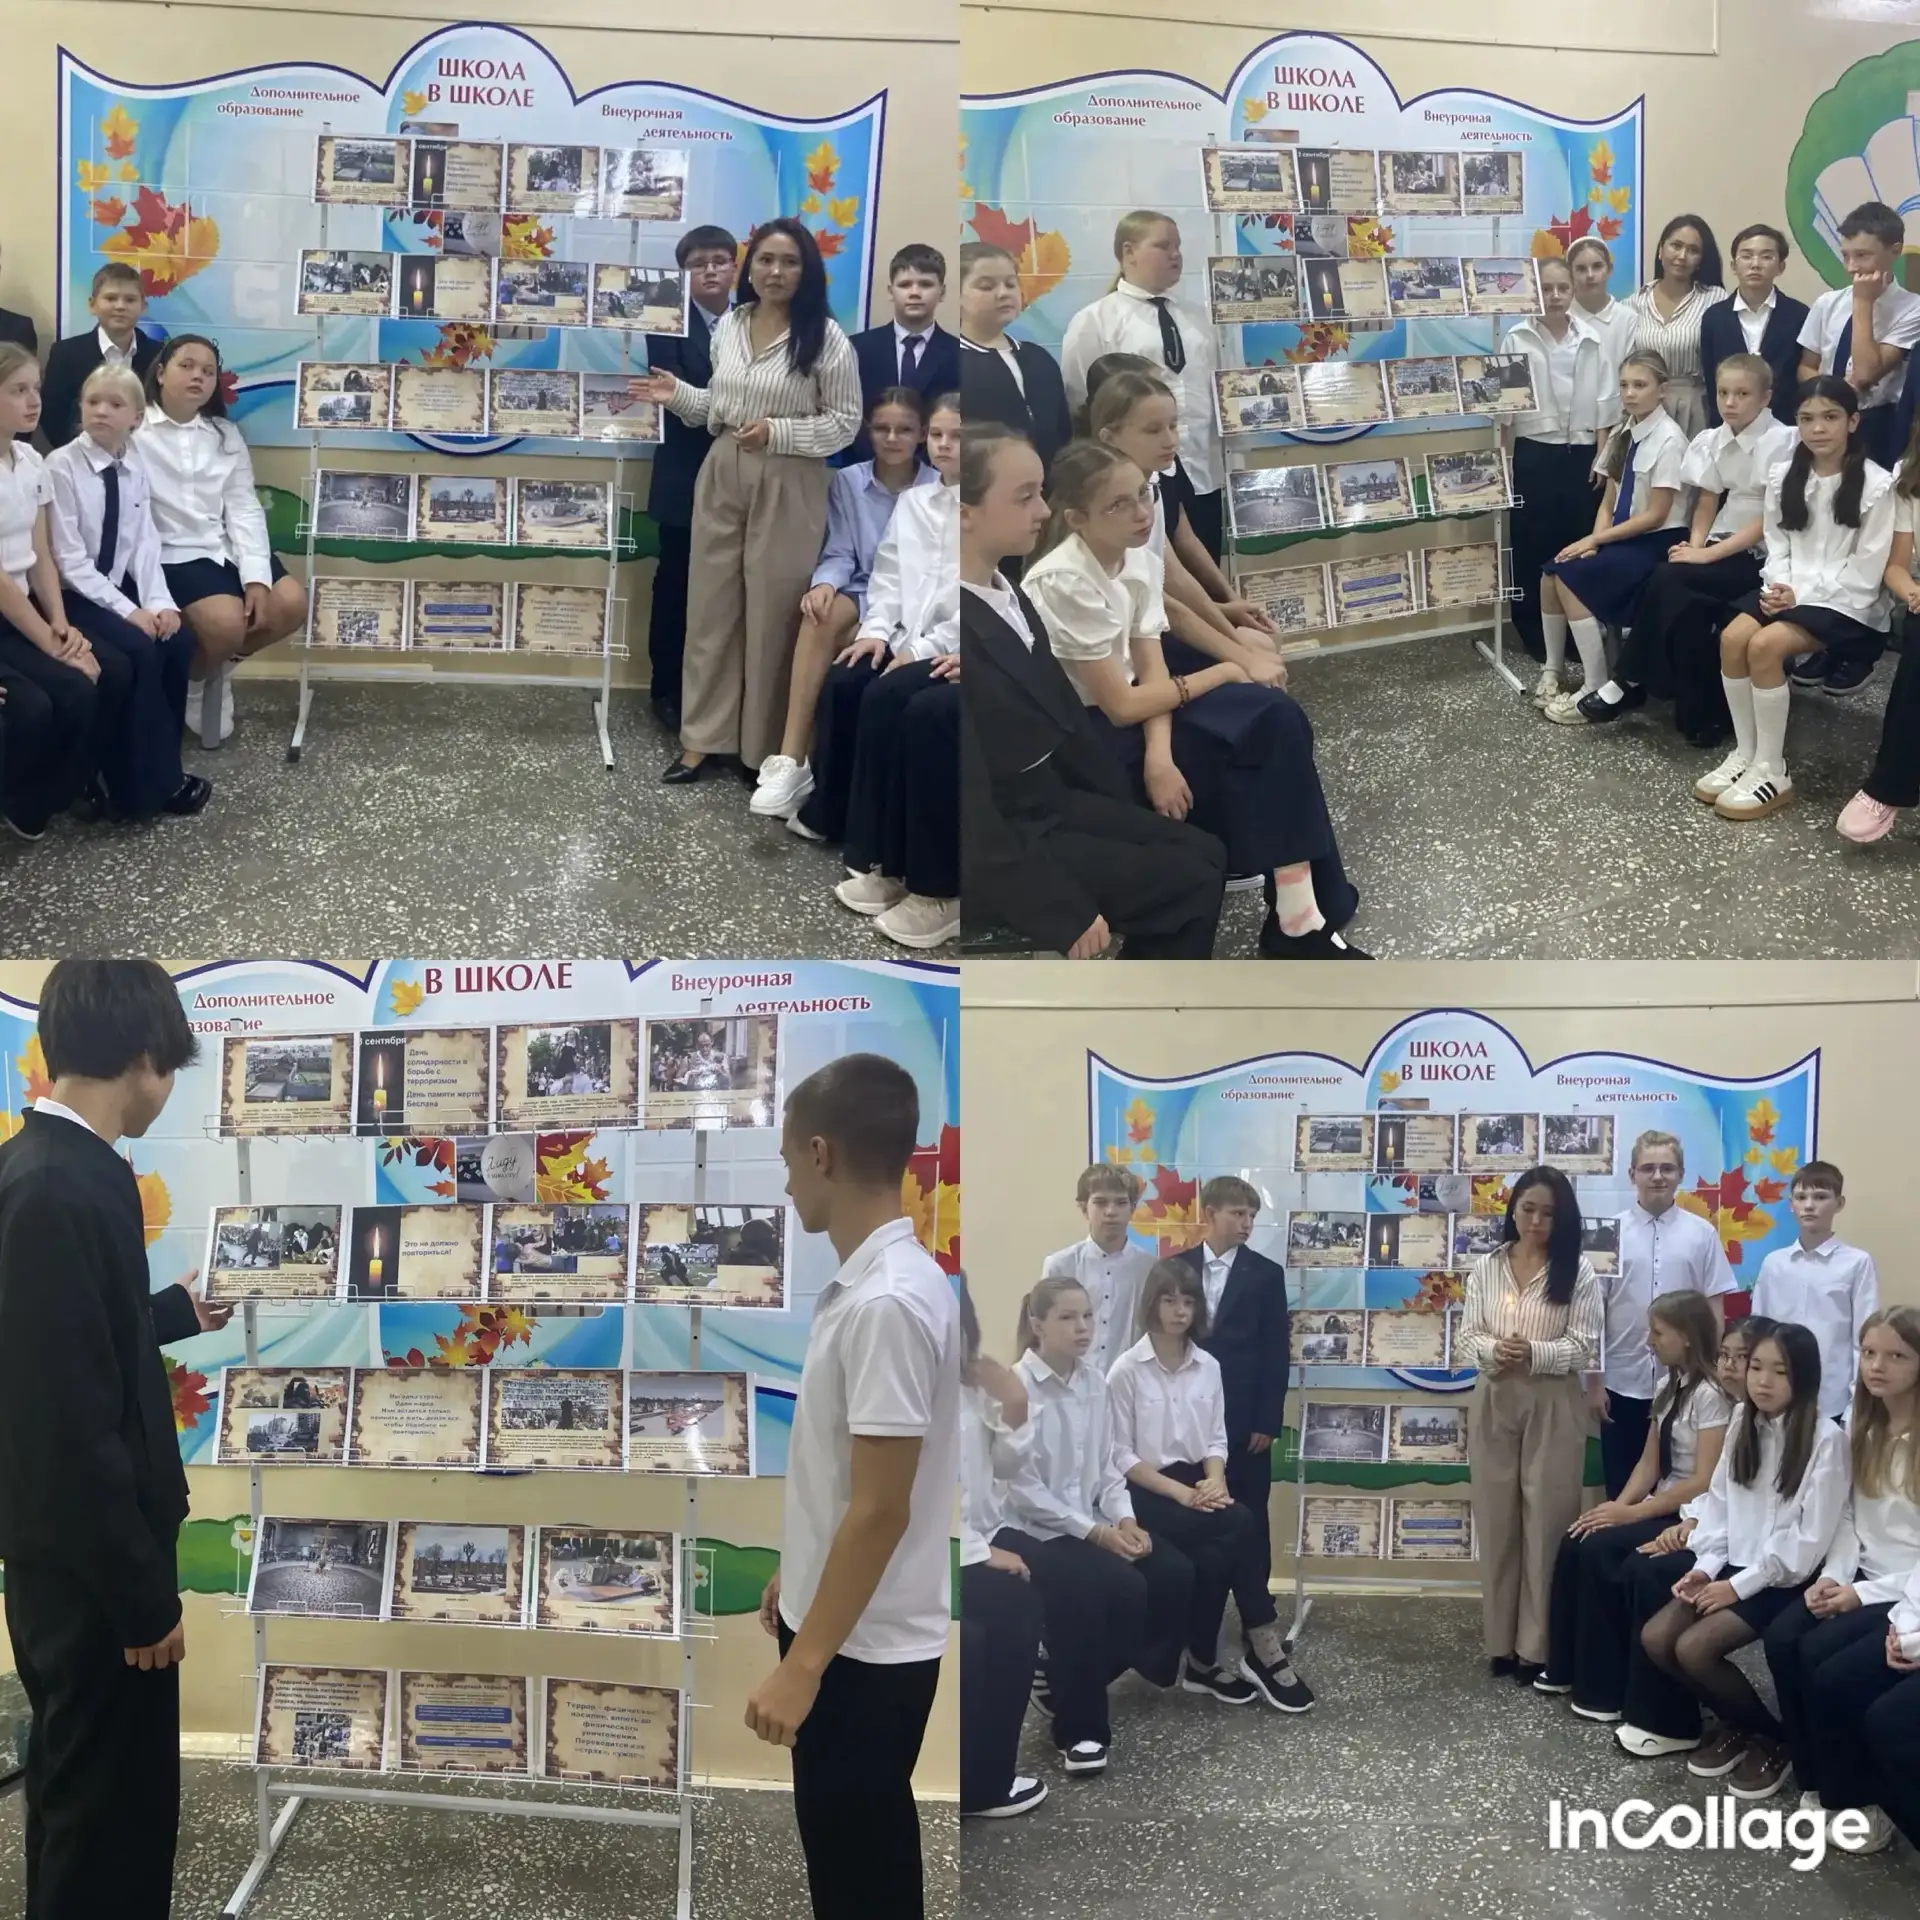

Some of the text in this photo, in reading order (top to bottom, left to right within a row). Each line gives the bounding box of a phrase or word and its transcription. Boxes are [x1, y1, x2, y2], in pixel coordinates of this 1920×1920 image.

[438, 57, 527, 82] ШКОЛА
[1273, 65, 1357, 89] ШКОЛА
[249, 85, 361, 104] Дополнительное
[427, 83, 535, 108] В ШКОЛЕ
[1087, 94, 1203, 112] Дополнительное
[1266, 90, 1366, 114] В ШКОЛЕ
[217, 103, 304, 117] образование
[601, 104, 683, 122] Внеурочная
[1053, 112, 1147, 128] образование
[1423, 110, 1492, 126] Внеурочная
[642, 127, 733, 141] деятельность
[1460, 131, 1533, 142] деятельность
[425, 962, 573, 995] В ШКОЛЕ
[671, 971, 793, 996] Внеурочная
[193, 991, 335, 1010] Дополнительное
[734, 995, 871, 1015] деятельность
[364, 1036, 407, 1047] сентября
[408, 1048, 429, 1057] День
[1409, 1040, 1488, 1058] ШКОЛА
[406, 1059, 461, 1067] солидарности
[406, 1067, 435, 1076] борьбе
[1401, 1063, 1496, 1082] В ШКОЛЕ
[406, 1078, 458, 1086] терроризмом
[1248, 1074, 1343, 1086] Дополнительное
[1556, 1074, 1631, 1089] Внеурочная
[406, 1091, 426, 1099] День
[1220, 1089, 1295, 1101] образование
[1595, 1092, 1678, 1102] деятельность
[406, 1100, 439, 1108] Беслана
[404, 1240, 418, 1248] Это
[401, 1249, 452, 1257] повториться!
[566, 1701, 596, 1711] Террор
